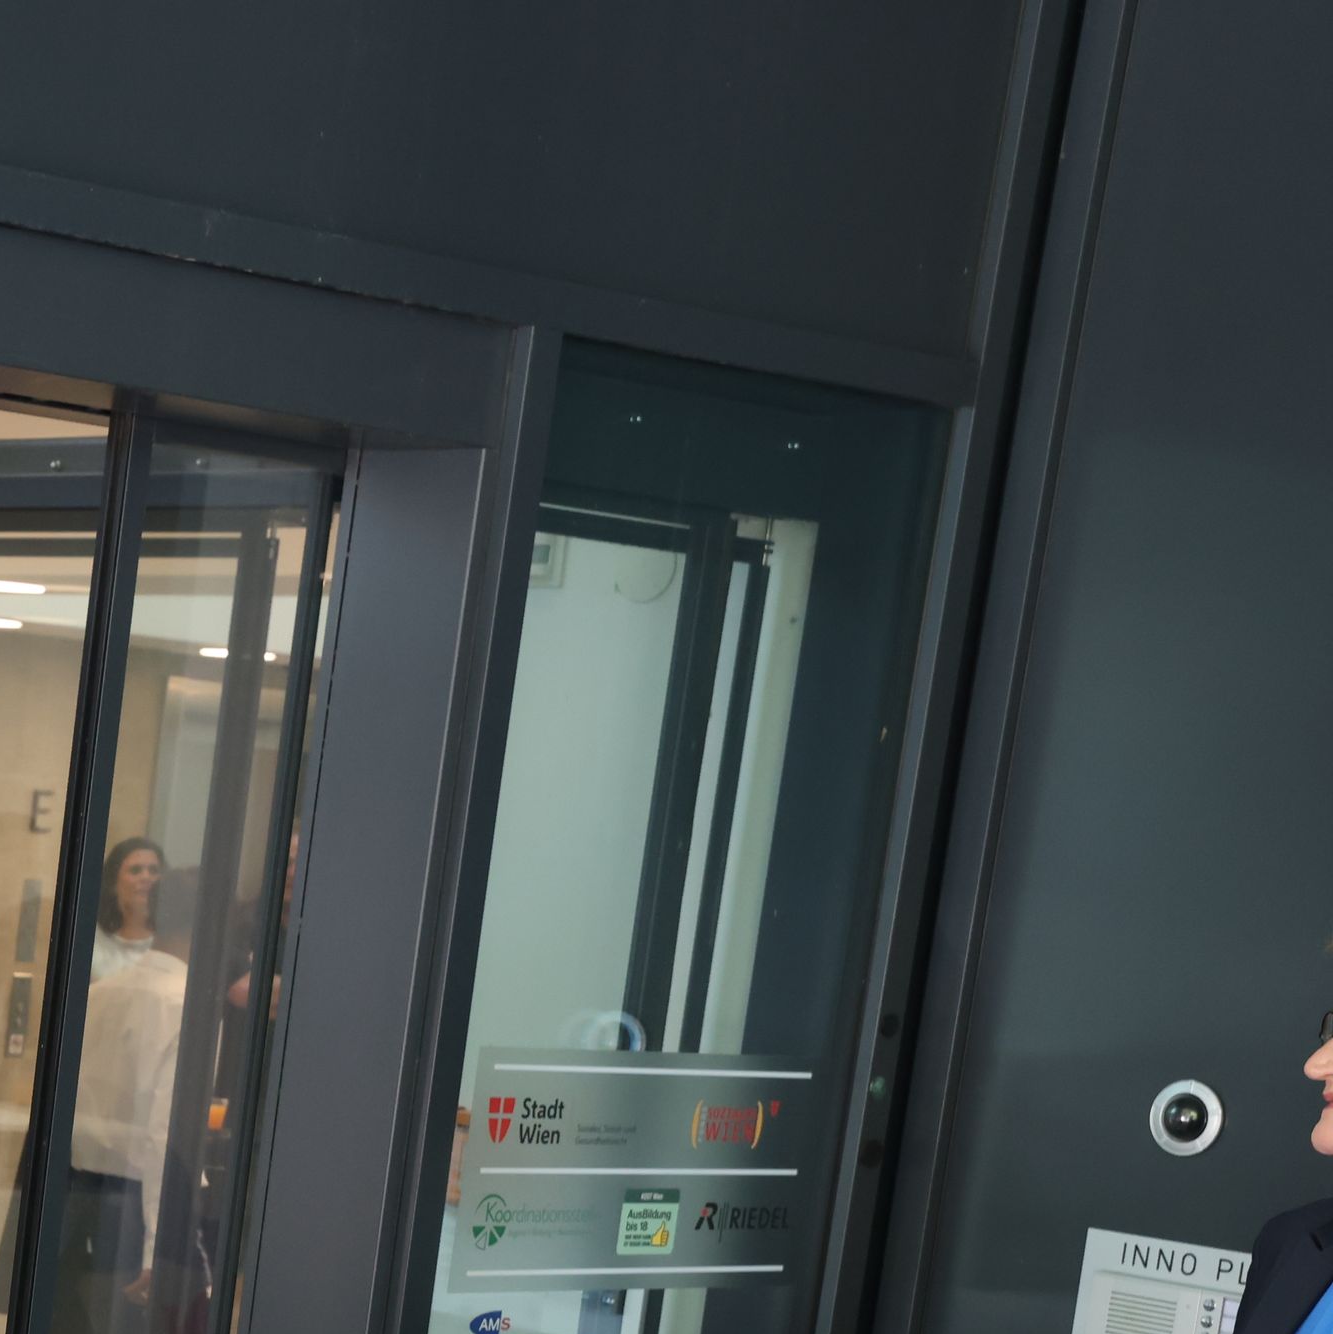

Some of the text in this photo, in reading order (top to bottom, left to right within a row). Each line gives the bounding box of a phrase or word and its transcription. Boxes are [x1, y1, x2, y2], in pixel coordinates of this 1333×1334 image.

[521, 1097, 564, 1119] Stadt
[519, 1123, 560, 1145] Wien
[729, 1206, 789, 1230] RIEDEL
[1121, 1242, 1198, 1277] INNO
[479, 1317, 511, 1332] AMS
